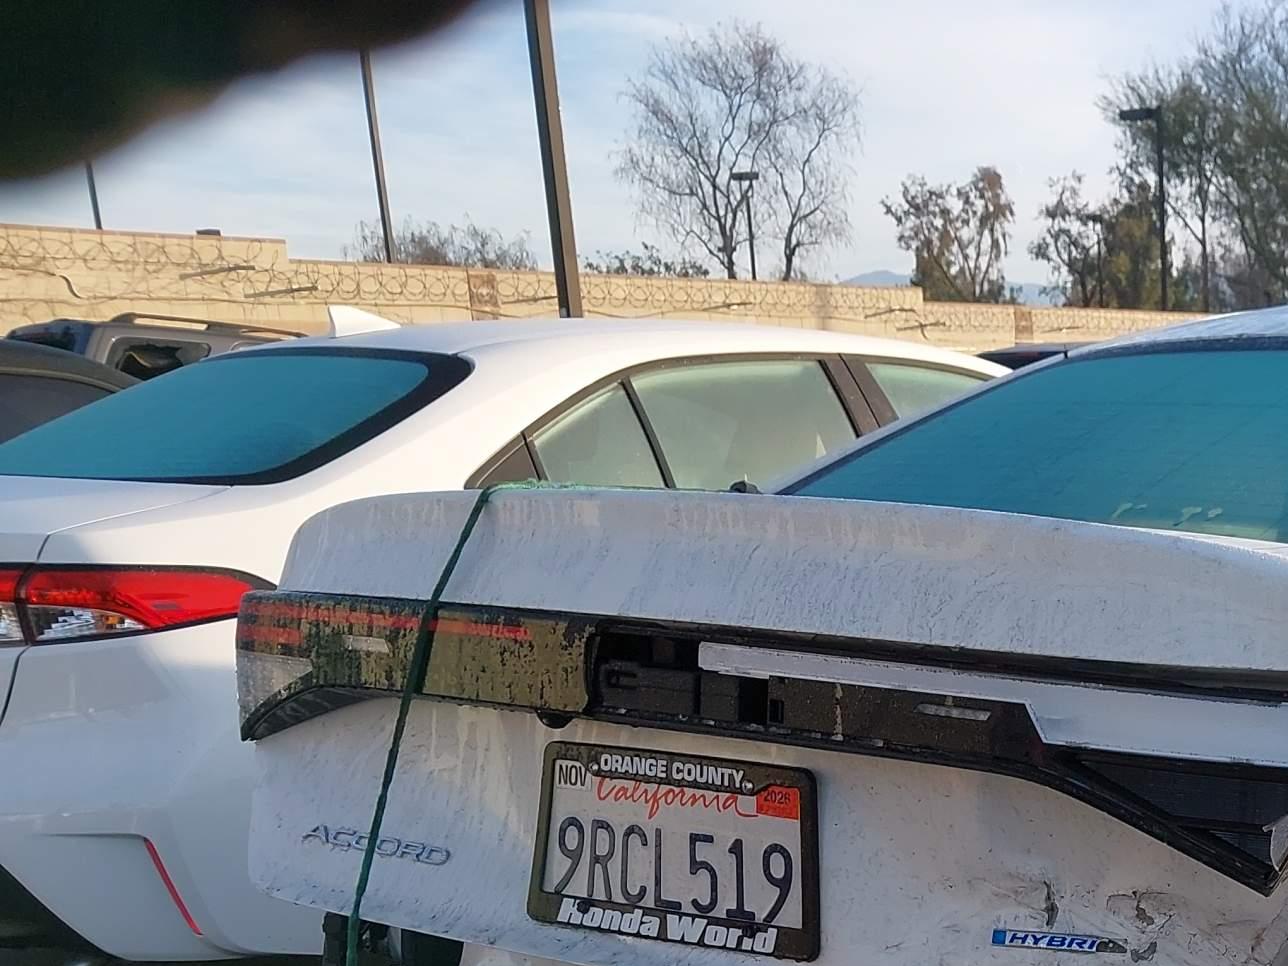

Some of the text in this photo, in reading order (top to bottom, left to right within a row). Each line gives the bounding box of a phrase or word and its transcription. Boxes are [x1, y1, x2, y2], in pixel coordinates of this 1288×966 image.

[558, 764, 587, 787] NOV
[600, 753, 744, 788] ORANGE COUNTY
[596, 775, 758, 820] California
[301, 823, 452, 866] ACCORD
[554, 815, 793, 925] 9RCL519
[556, 897, 660, 937] Honda
[1008, 932, 1098, 950] HYBRI
